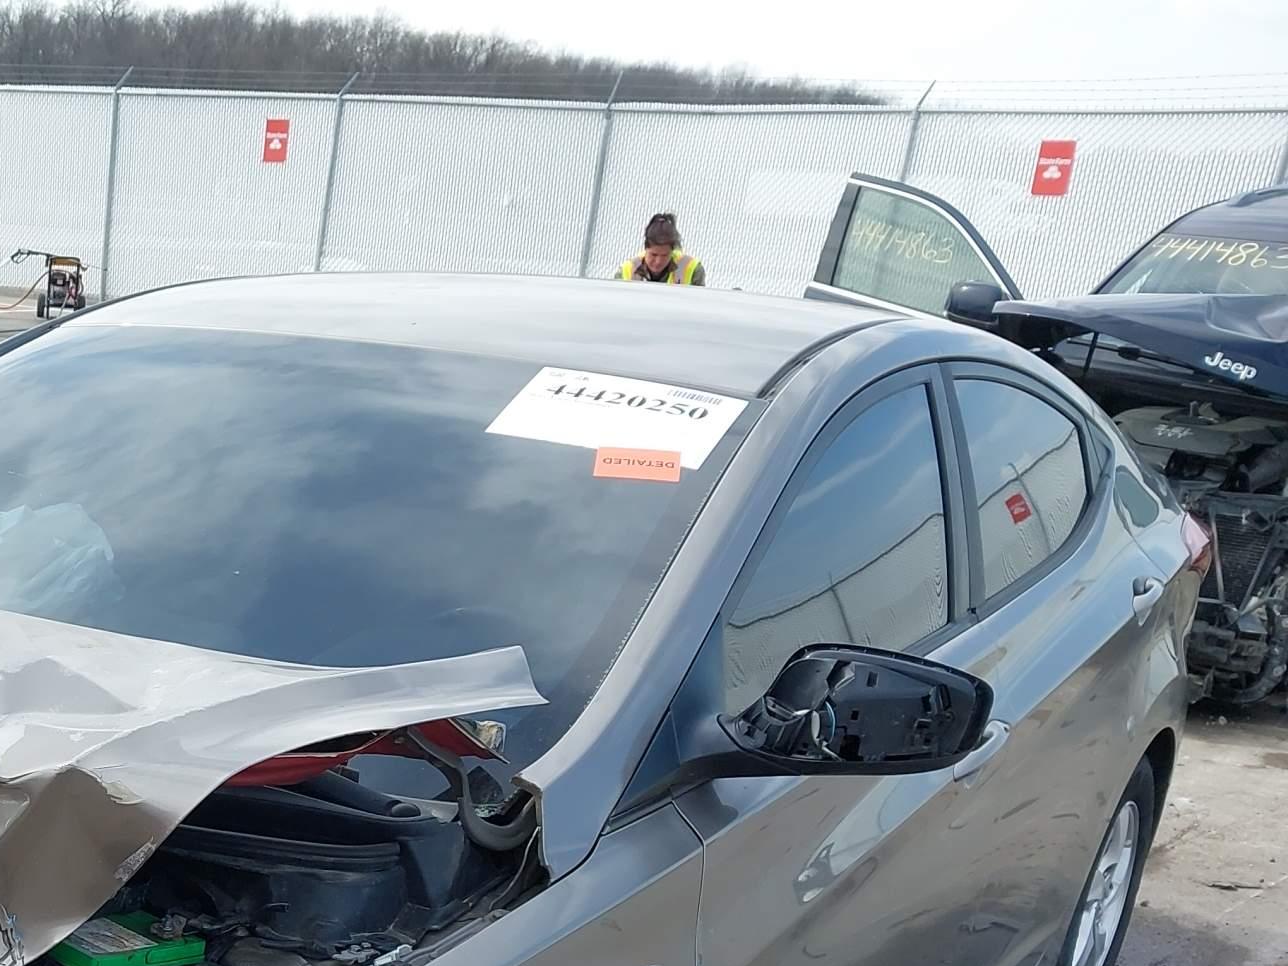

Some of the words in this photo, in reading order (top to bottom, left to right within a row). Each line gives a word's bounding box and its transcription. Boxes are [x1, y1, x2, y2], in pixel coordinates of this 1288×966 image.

[1204, 351, 1258, 381] Jeep
[546, 384, 709, 420] 44420250
[602, 456, 676, 469] DETAILED
